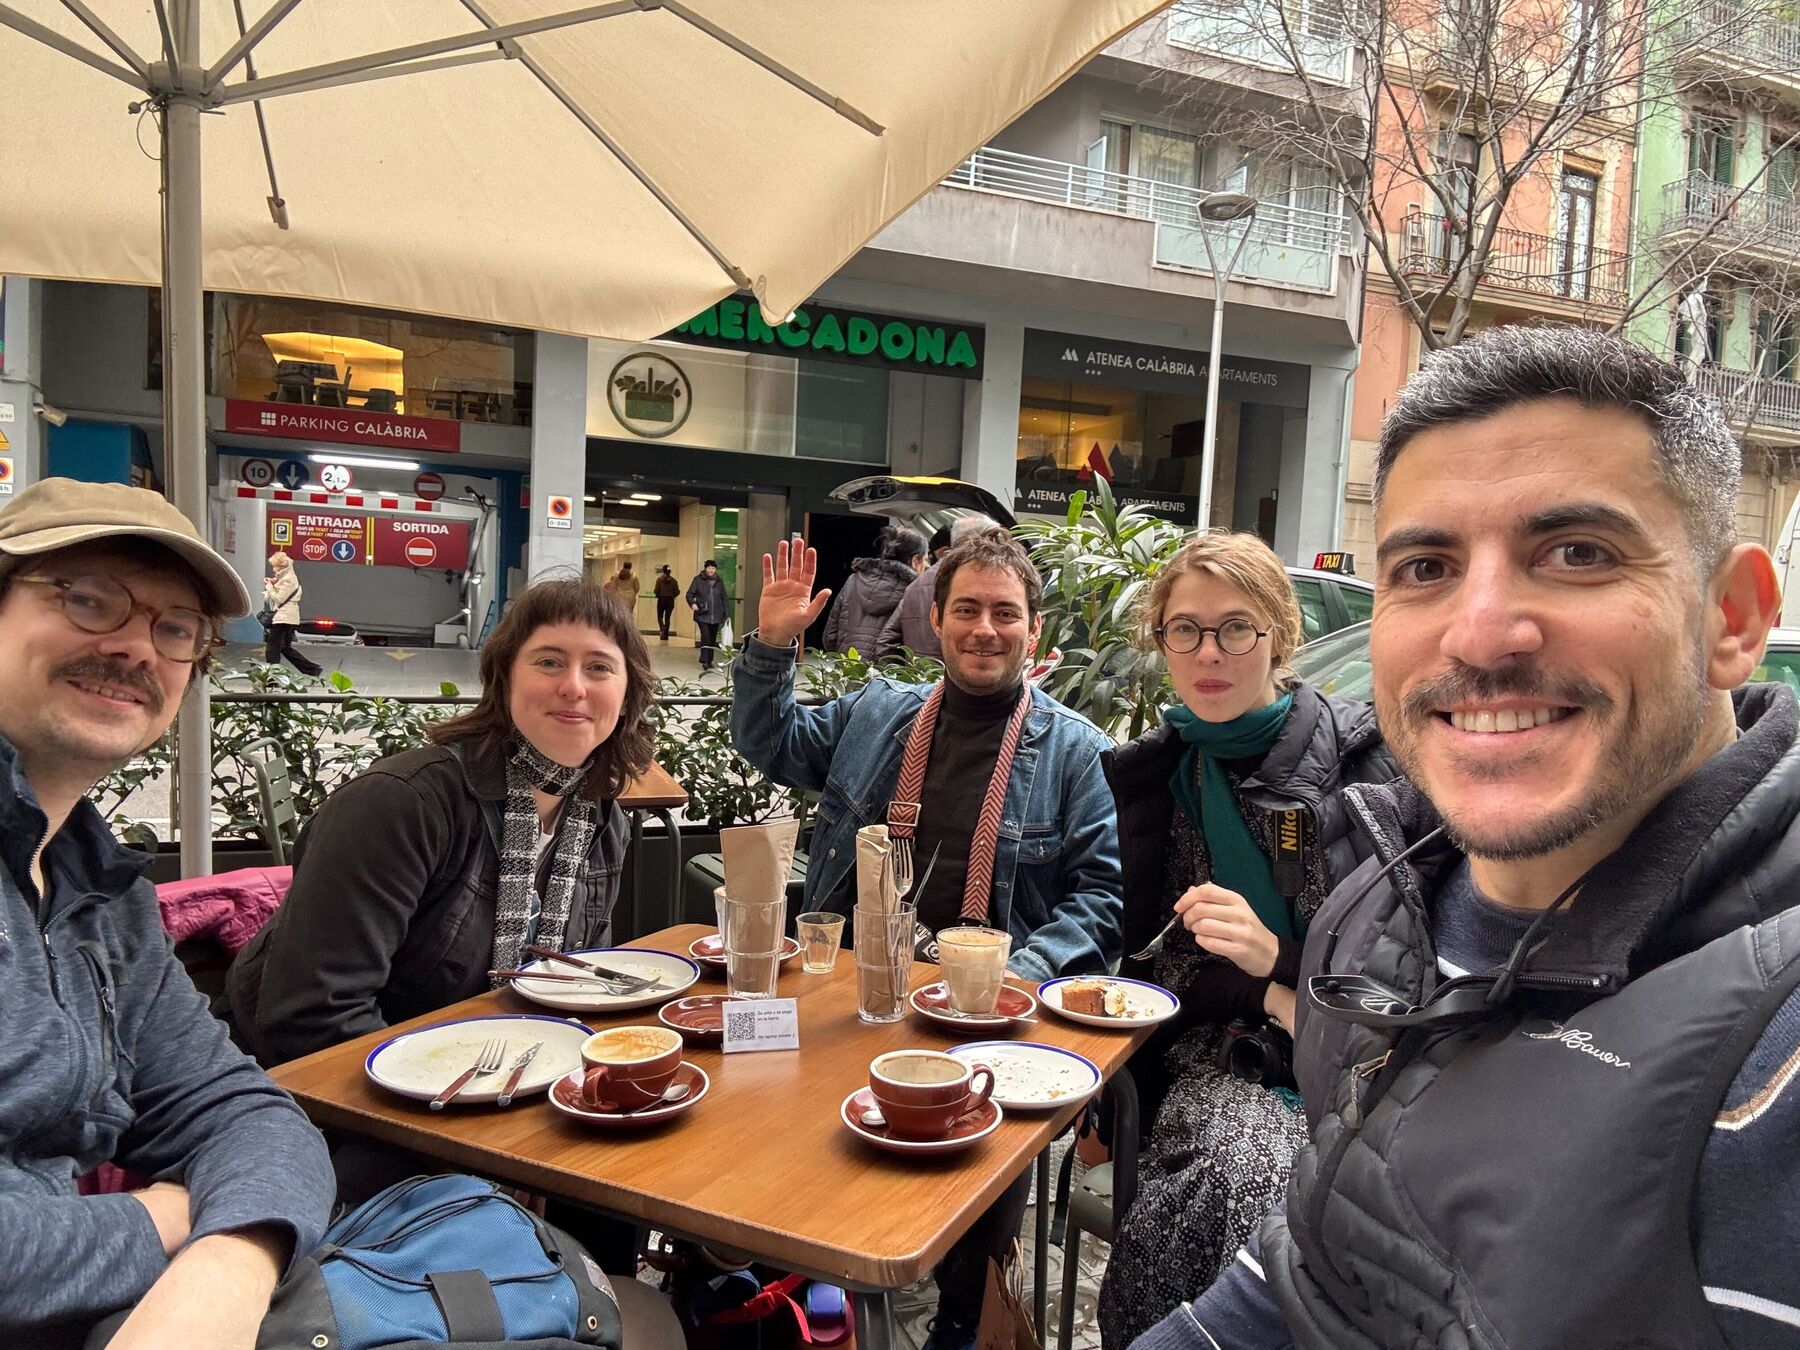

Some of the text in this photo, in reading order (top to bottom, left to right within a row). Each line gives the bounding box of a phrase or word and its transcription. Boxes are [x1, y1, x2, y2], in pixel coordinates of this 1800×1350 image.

[676, 300, 977, 368] MERCADONA
[1086, 351, 1278, 386] ATENEA CALÀBRIA ARTAMENTS
[280, 414, 428, 440] PARKING CALÀBRIA
[251, 467, 267, 478] 10
[1028, 489, 1067, 503] ATENEA
[1068, 491, 1118, 506] CÀBA
[297, 515, 362, 529] ENTRADA
[392, 521, 450, 535] SORTIDA
[305, 544, 325, 554] STOP
[1322, 554, 1341, 569] TAXI
[1280, 809, 1297, 851] Niko
[1561, 1029, 1631, 1069] Bauer
